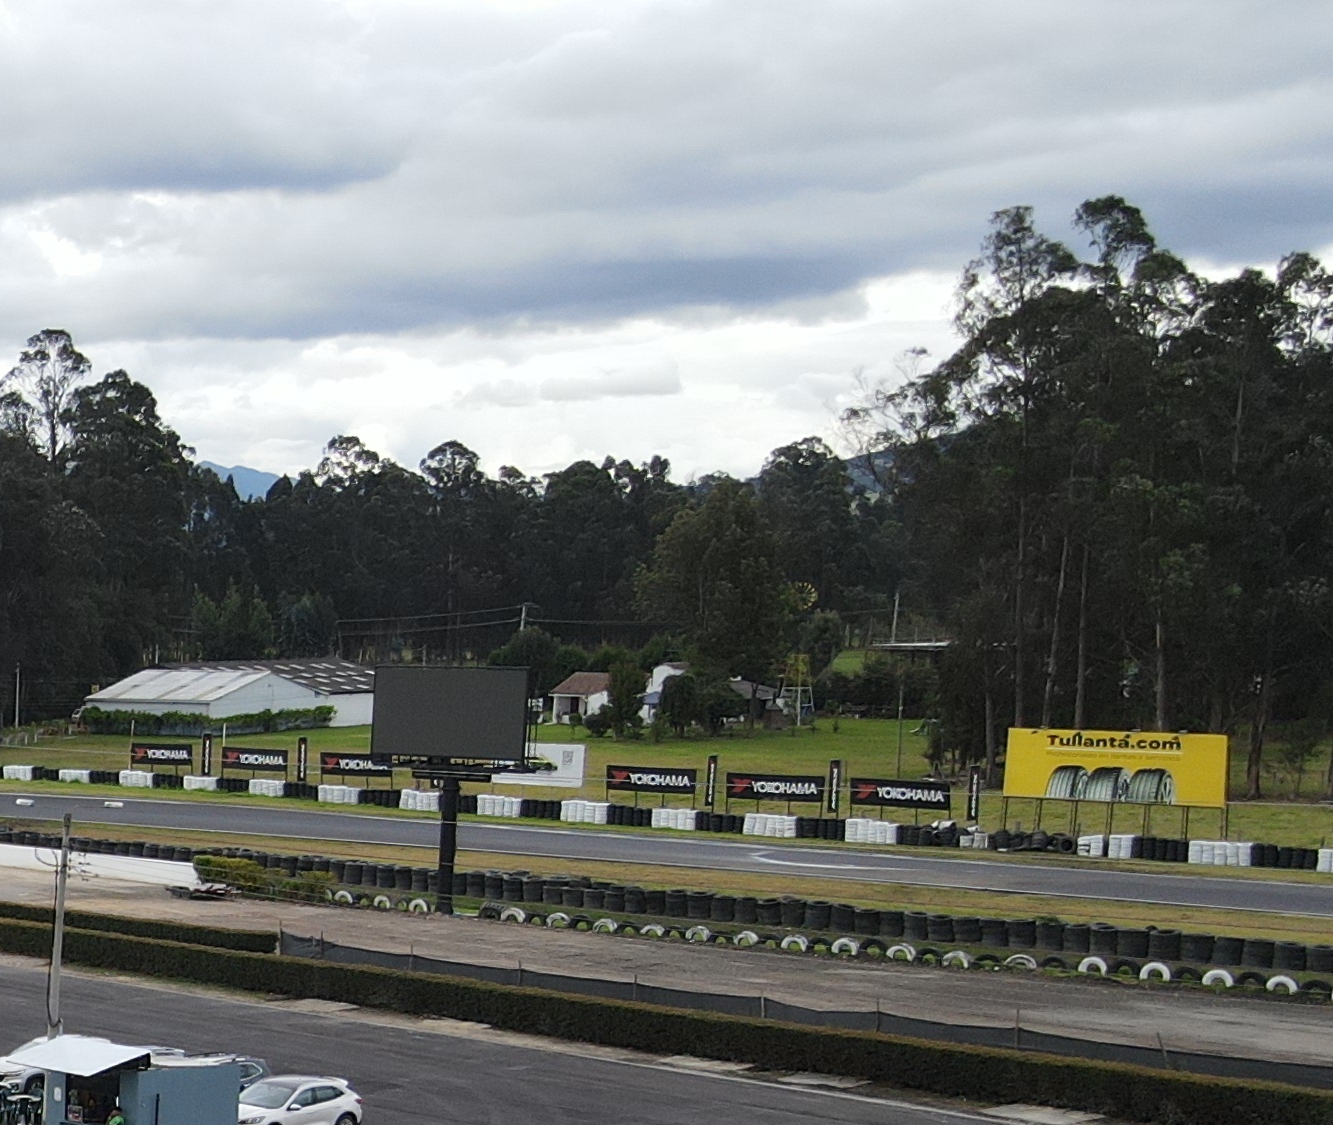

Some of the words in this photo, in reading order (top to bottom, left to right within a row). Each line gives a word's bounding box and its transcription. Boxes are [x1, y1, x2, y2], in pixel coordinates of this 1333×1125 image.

[147, 749, 188, 760] YOKOHAMA
[239, 754, 283, 765] YOKOHAMA
[629, 773, 690, 787] YOKOHAMA
[752, 781, 817, 795] YOKOHAMA
[876, 787, 944, 802] YOKOHAMA
